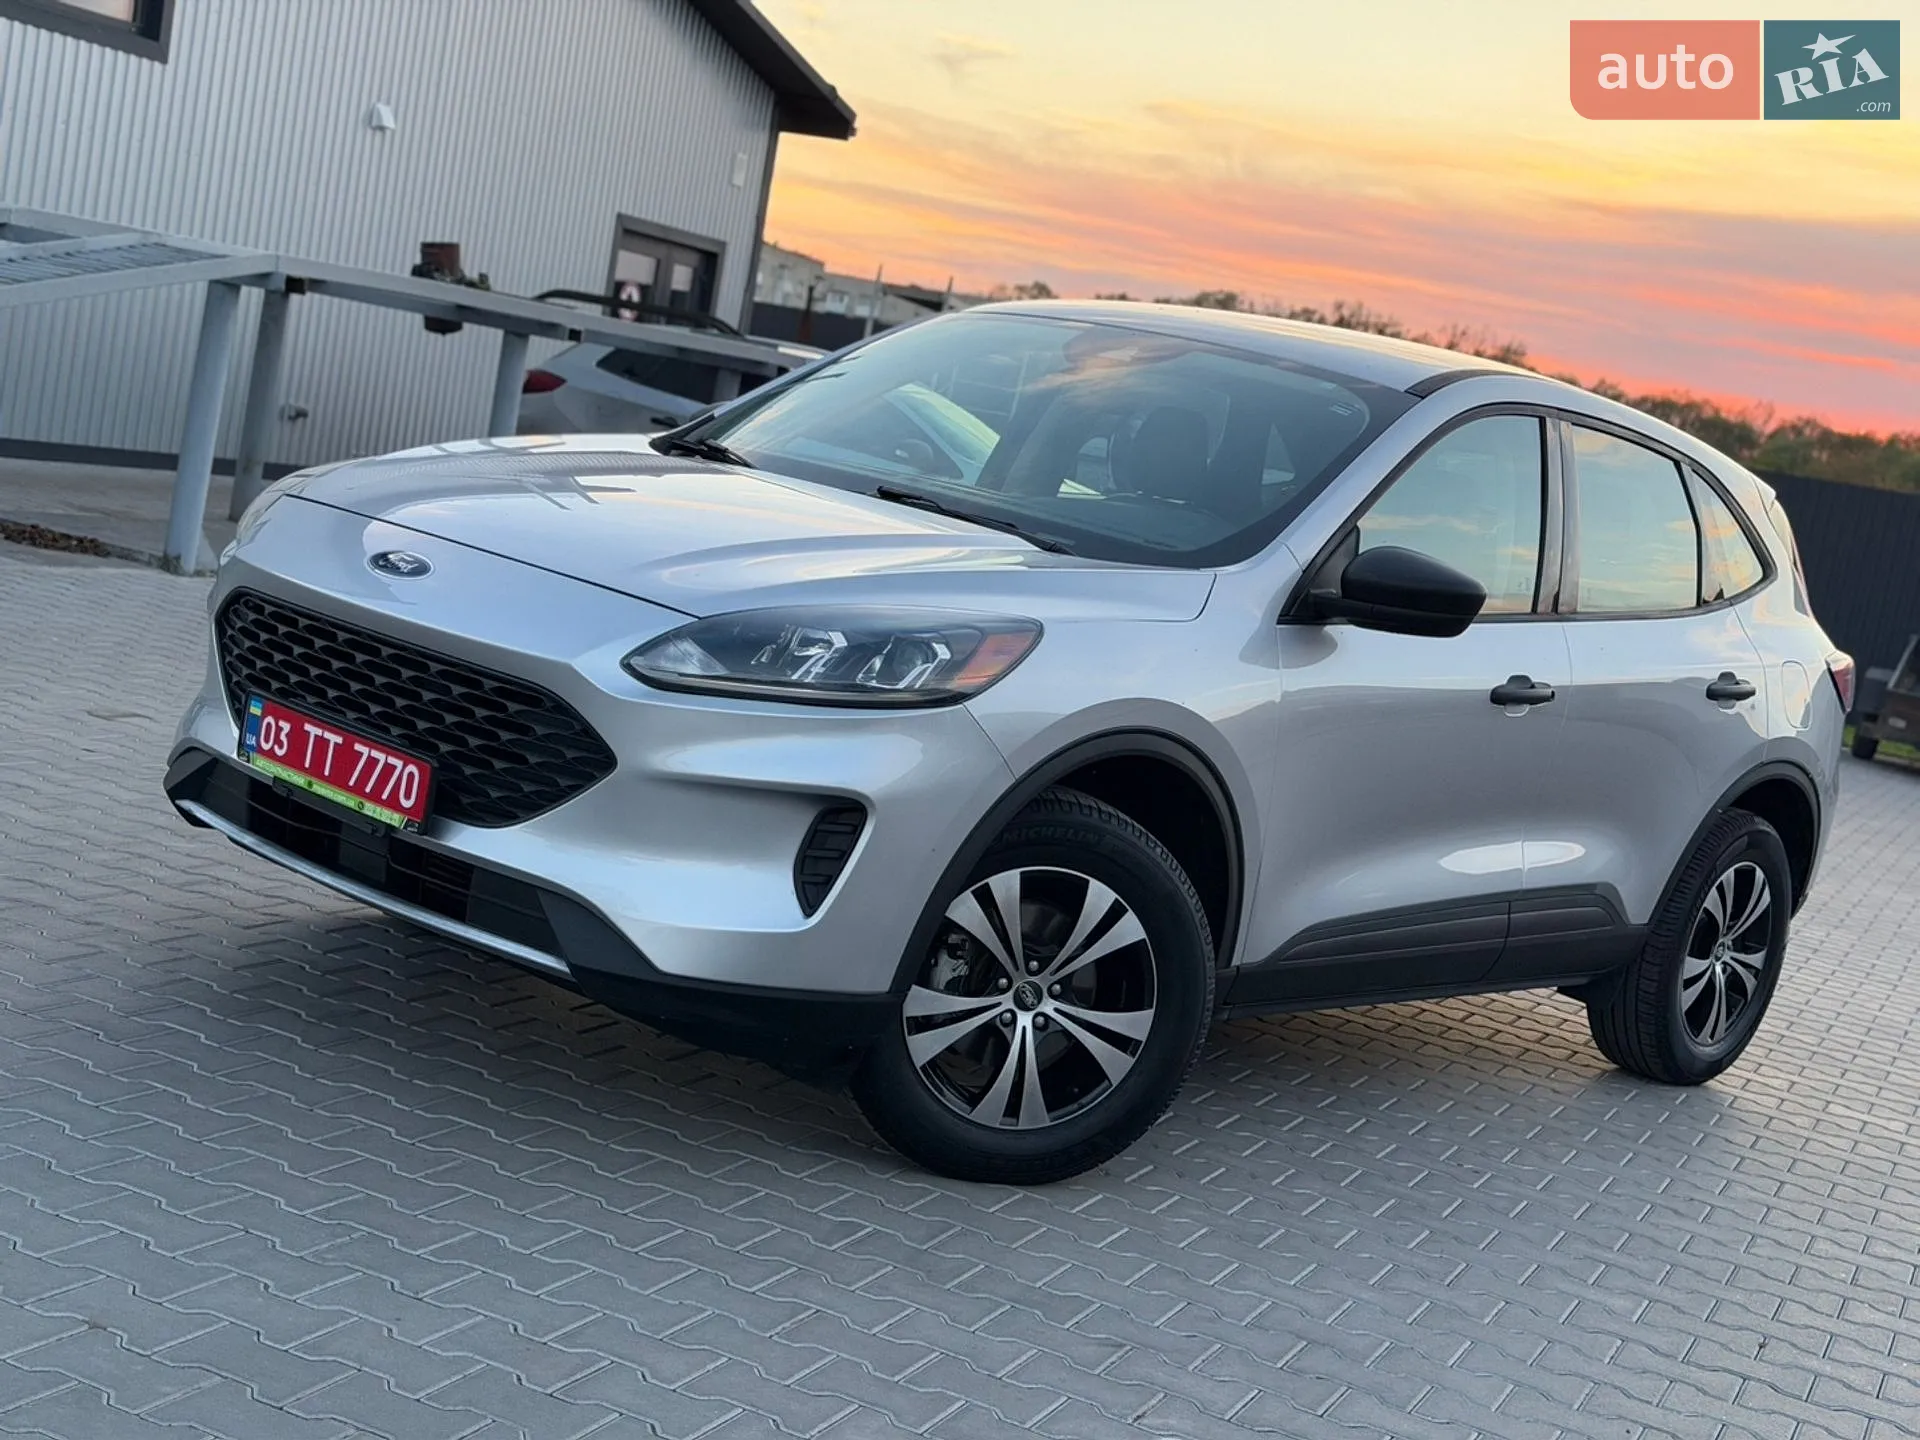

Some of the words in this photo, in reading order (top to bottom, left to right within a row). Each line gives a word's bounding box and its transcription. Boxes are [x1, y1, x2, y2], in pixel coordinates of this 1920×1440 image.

[378, 552, 419, 573] Ford
[260, 715, 291, 756] 03
[303, 723, 343, 777] TT
[348, 742, 420, 809] 7770
[1001, 826, 1104, 844] MICHELIN
